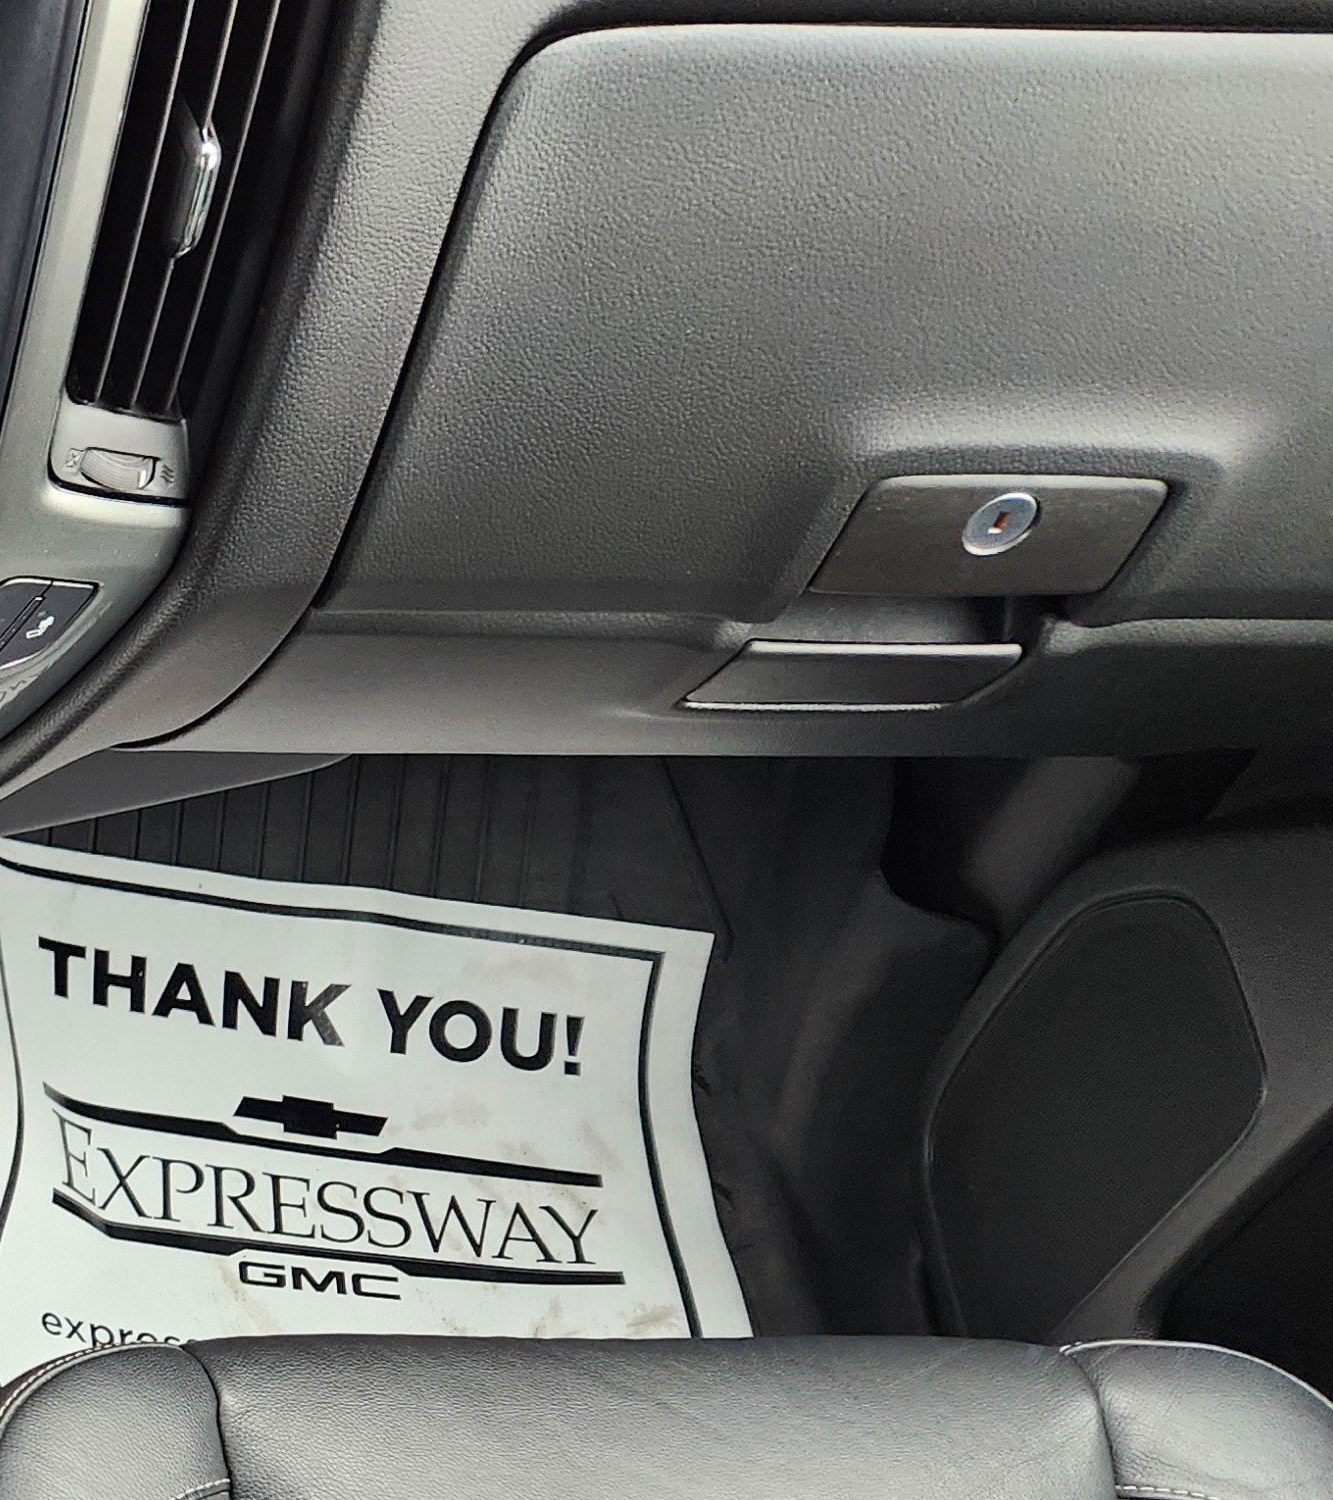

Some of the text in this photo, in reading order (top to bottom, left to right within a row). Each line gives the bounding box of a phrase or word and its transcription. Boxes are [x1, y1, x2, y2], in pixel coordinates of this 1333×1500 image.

[37, 936, 585, 1077] THANK YOU!
[51, 1109, 599, 1267] EXPRESSWAY
[237, 1261, 402, 1301] GMC
